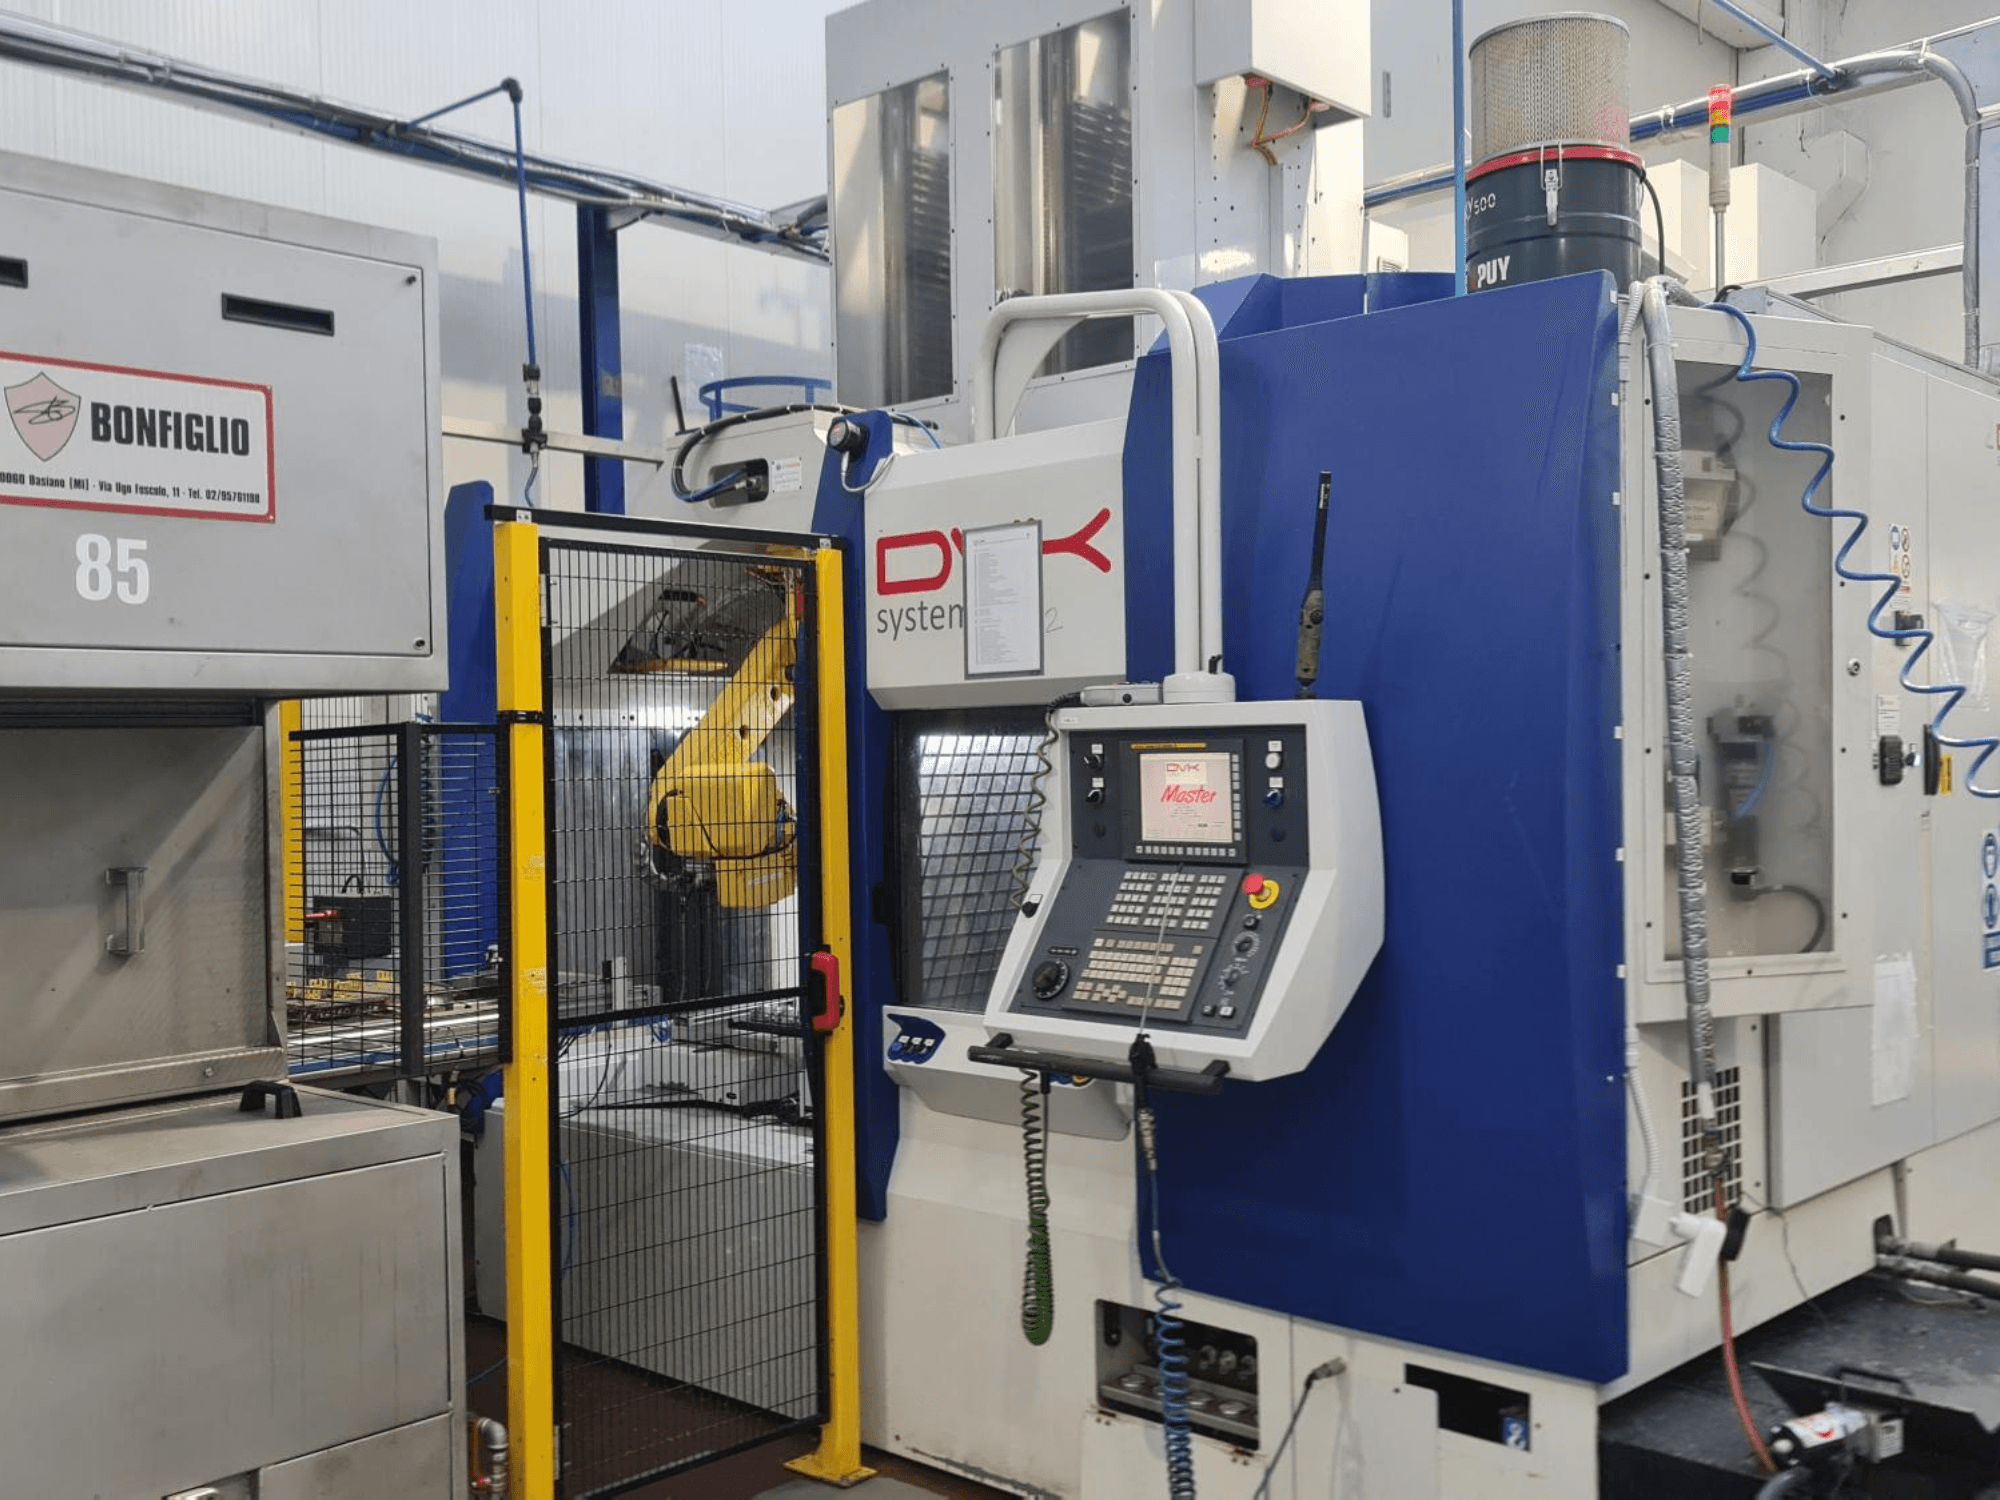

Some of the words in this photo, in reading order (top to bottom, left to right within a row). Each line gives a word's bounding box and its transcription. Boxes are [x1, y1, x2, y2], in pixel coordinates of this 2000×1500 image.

[1477, 255, 1510, 289] PUY
[90, 401, 250, 457] BONFIGLIO
[99, 480, 112, 492] Via
[115, 481, 132, 496] Ugo
[188, 487, 202, 500] Tel.
[75, 533, 150, 605] 85
[1160, 784, 1217, 803] Master
